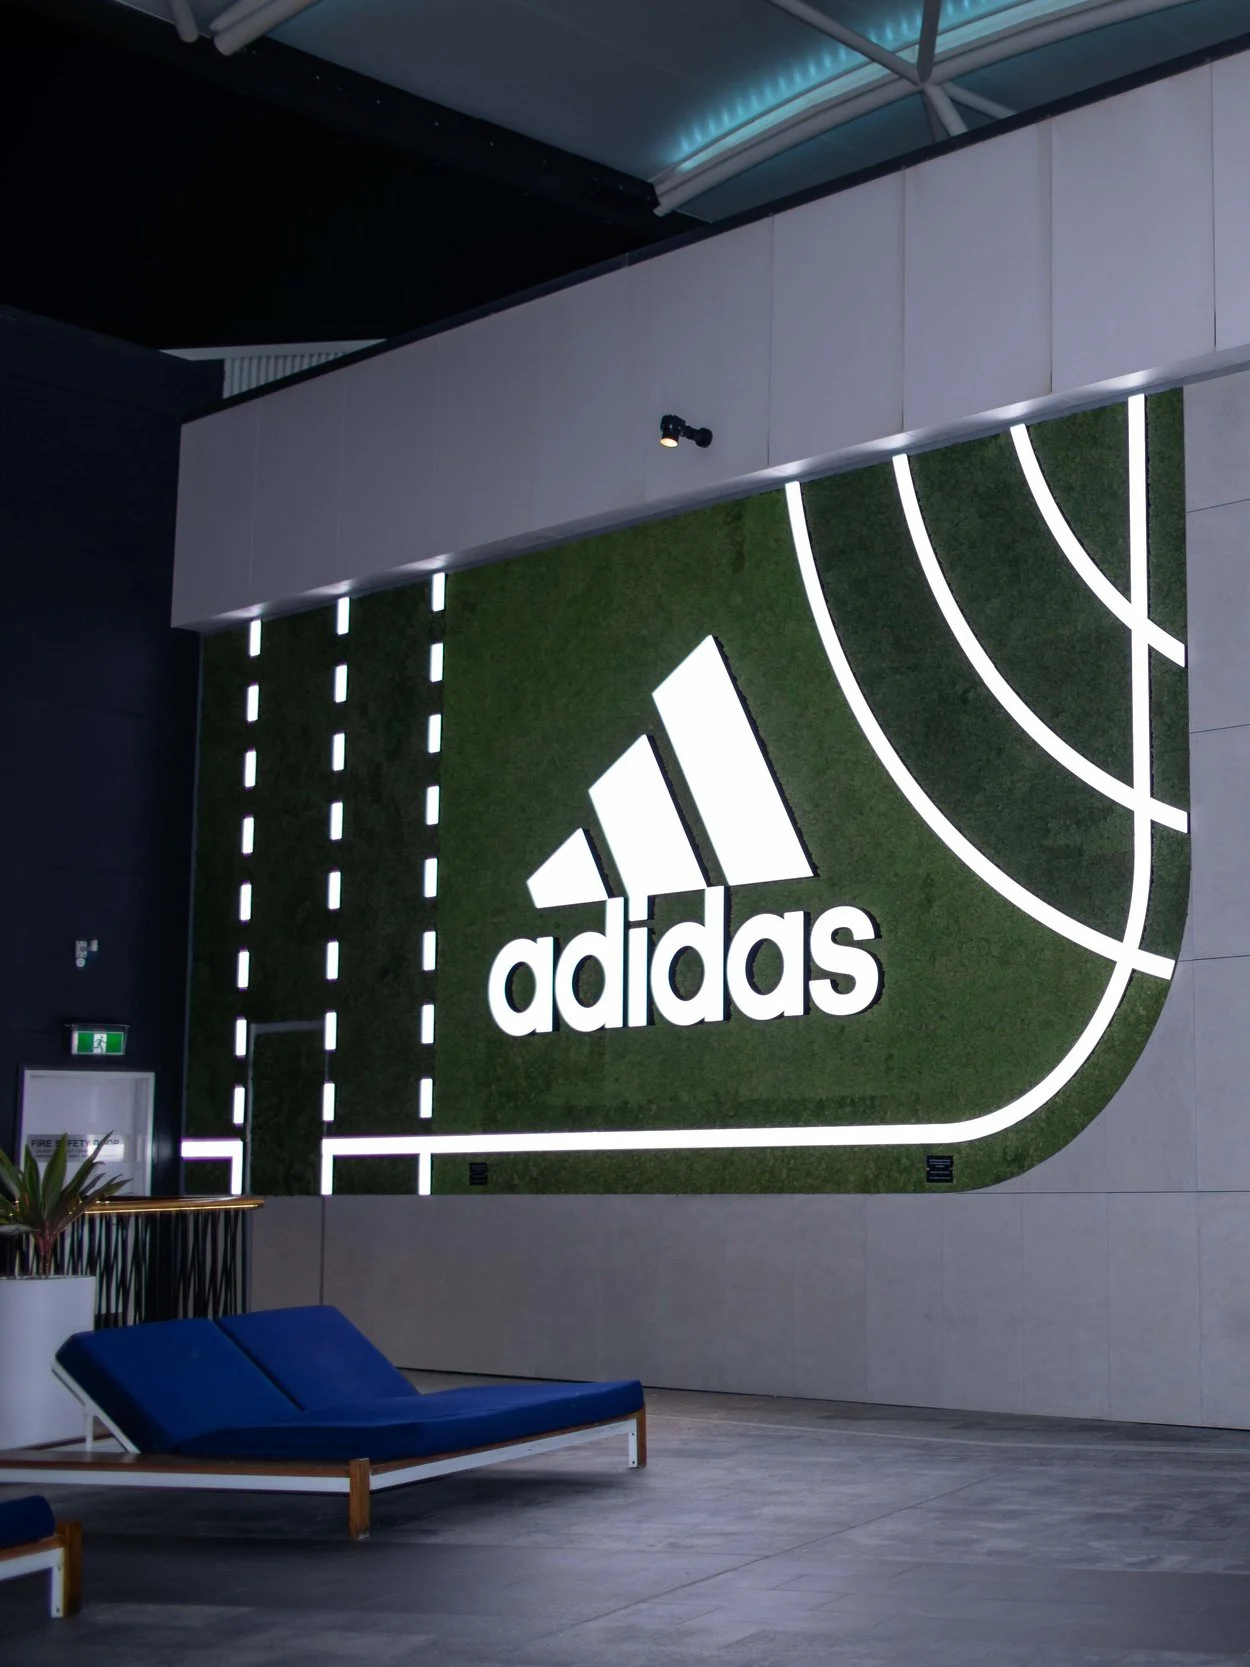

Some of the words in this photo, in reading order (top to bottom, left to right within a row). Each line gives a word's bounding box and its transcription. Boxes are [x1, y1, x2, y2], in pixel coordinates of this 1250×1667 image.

[488, 885, 880, 1037] adidas
[31, 1139, 53, 1148] FIRE
[55, 1139, 90, 1148] SFETY
